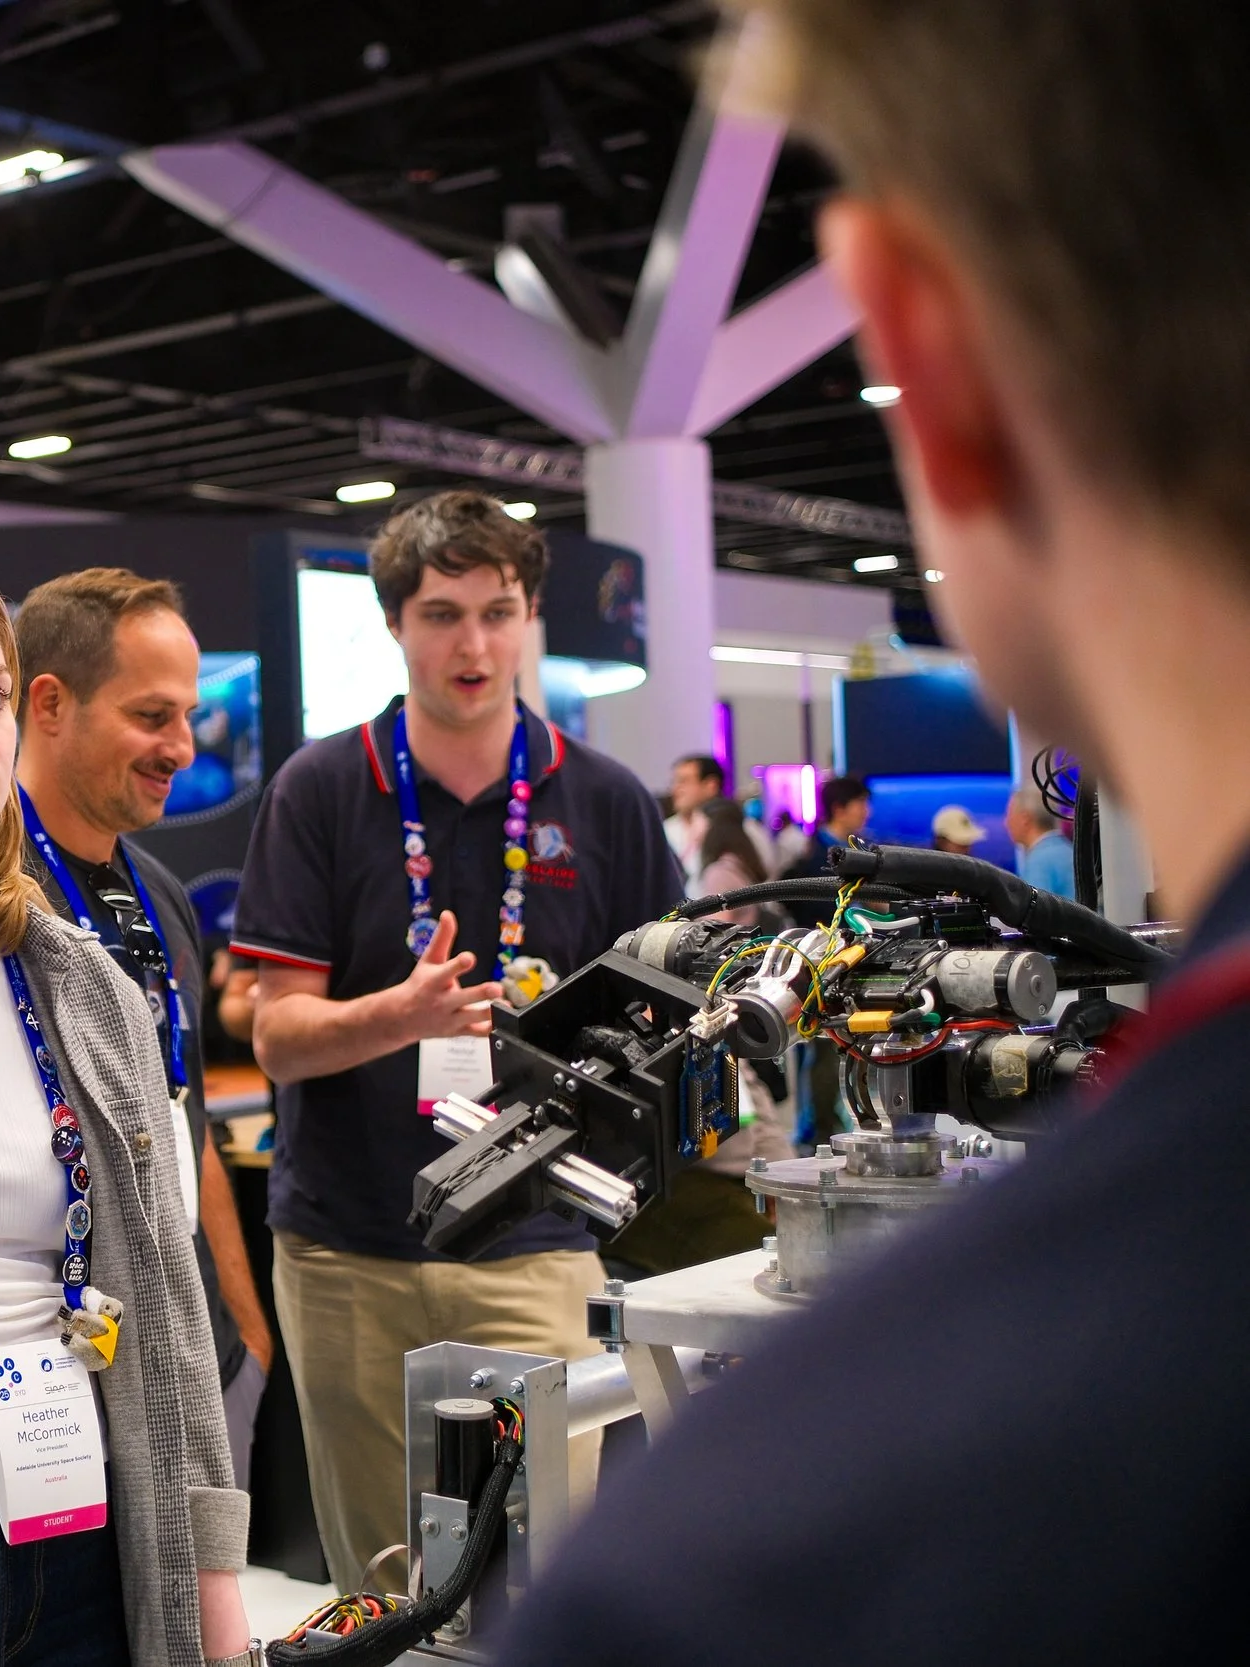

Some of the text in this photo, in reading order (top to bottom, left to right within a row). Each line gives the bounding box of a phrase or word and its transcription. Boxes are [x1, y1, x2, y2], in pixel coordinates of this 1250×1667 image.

[69, 1262, 85, 1270] SPACE
[0, 1390, 10, 1399] 25
[22, 1407, 69, 1423] Heather
[17, 1422, 82, 1443] McCormick
[46, 1443, 68, 1451] President
[37, 1459, 60, 1468] University
[45, 1474, 68, 1484] Australia
[43, 1514, 74, 1527] STUDENT
